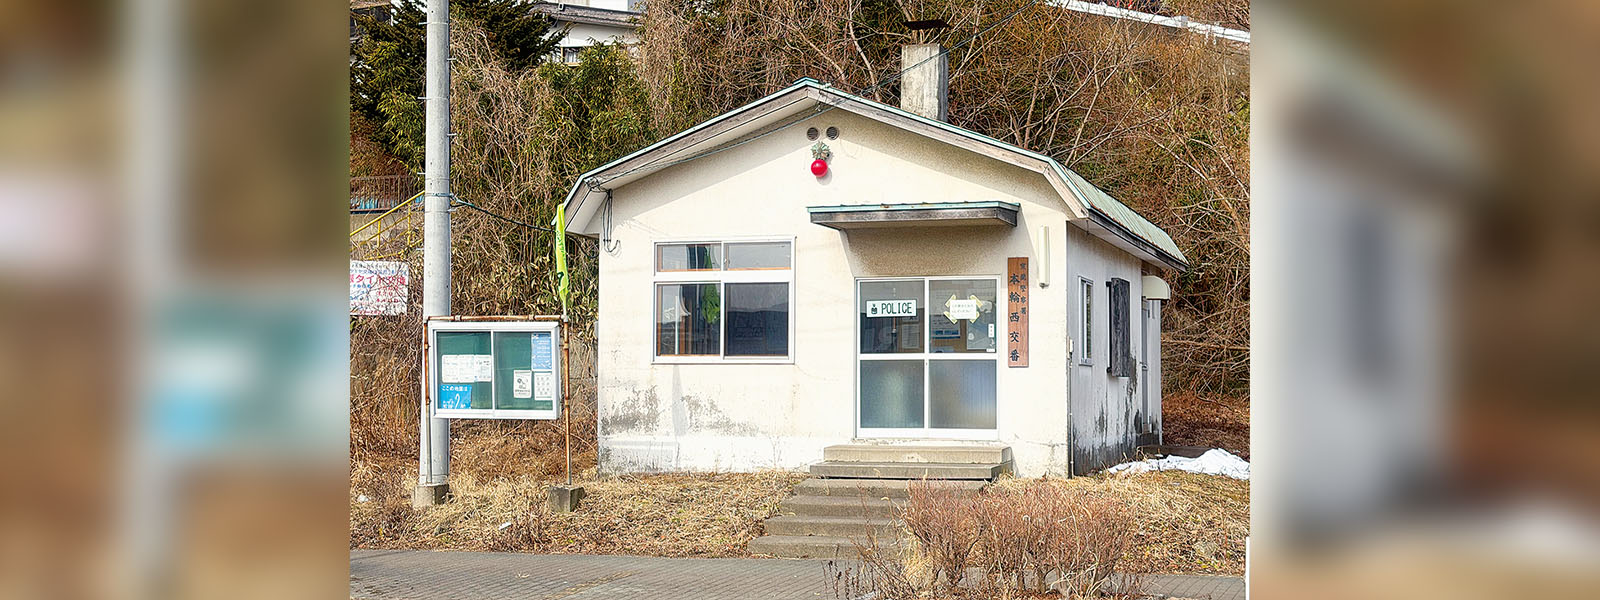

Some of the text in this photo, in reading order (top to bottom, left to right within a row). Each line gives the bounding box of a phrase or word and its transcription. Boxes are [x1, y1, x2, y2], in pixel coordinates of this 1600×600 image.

[881, 302, 913, 315] POLICE
[1009, 273, 1020, 362] 本輪西交番
